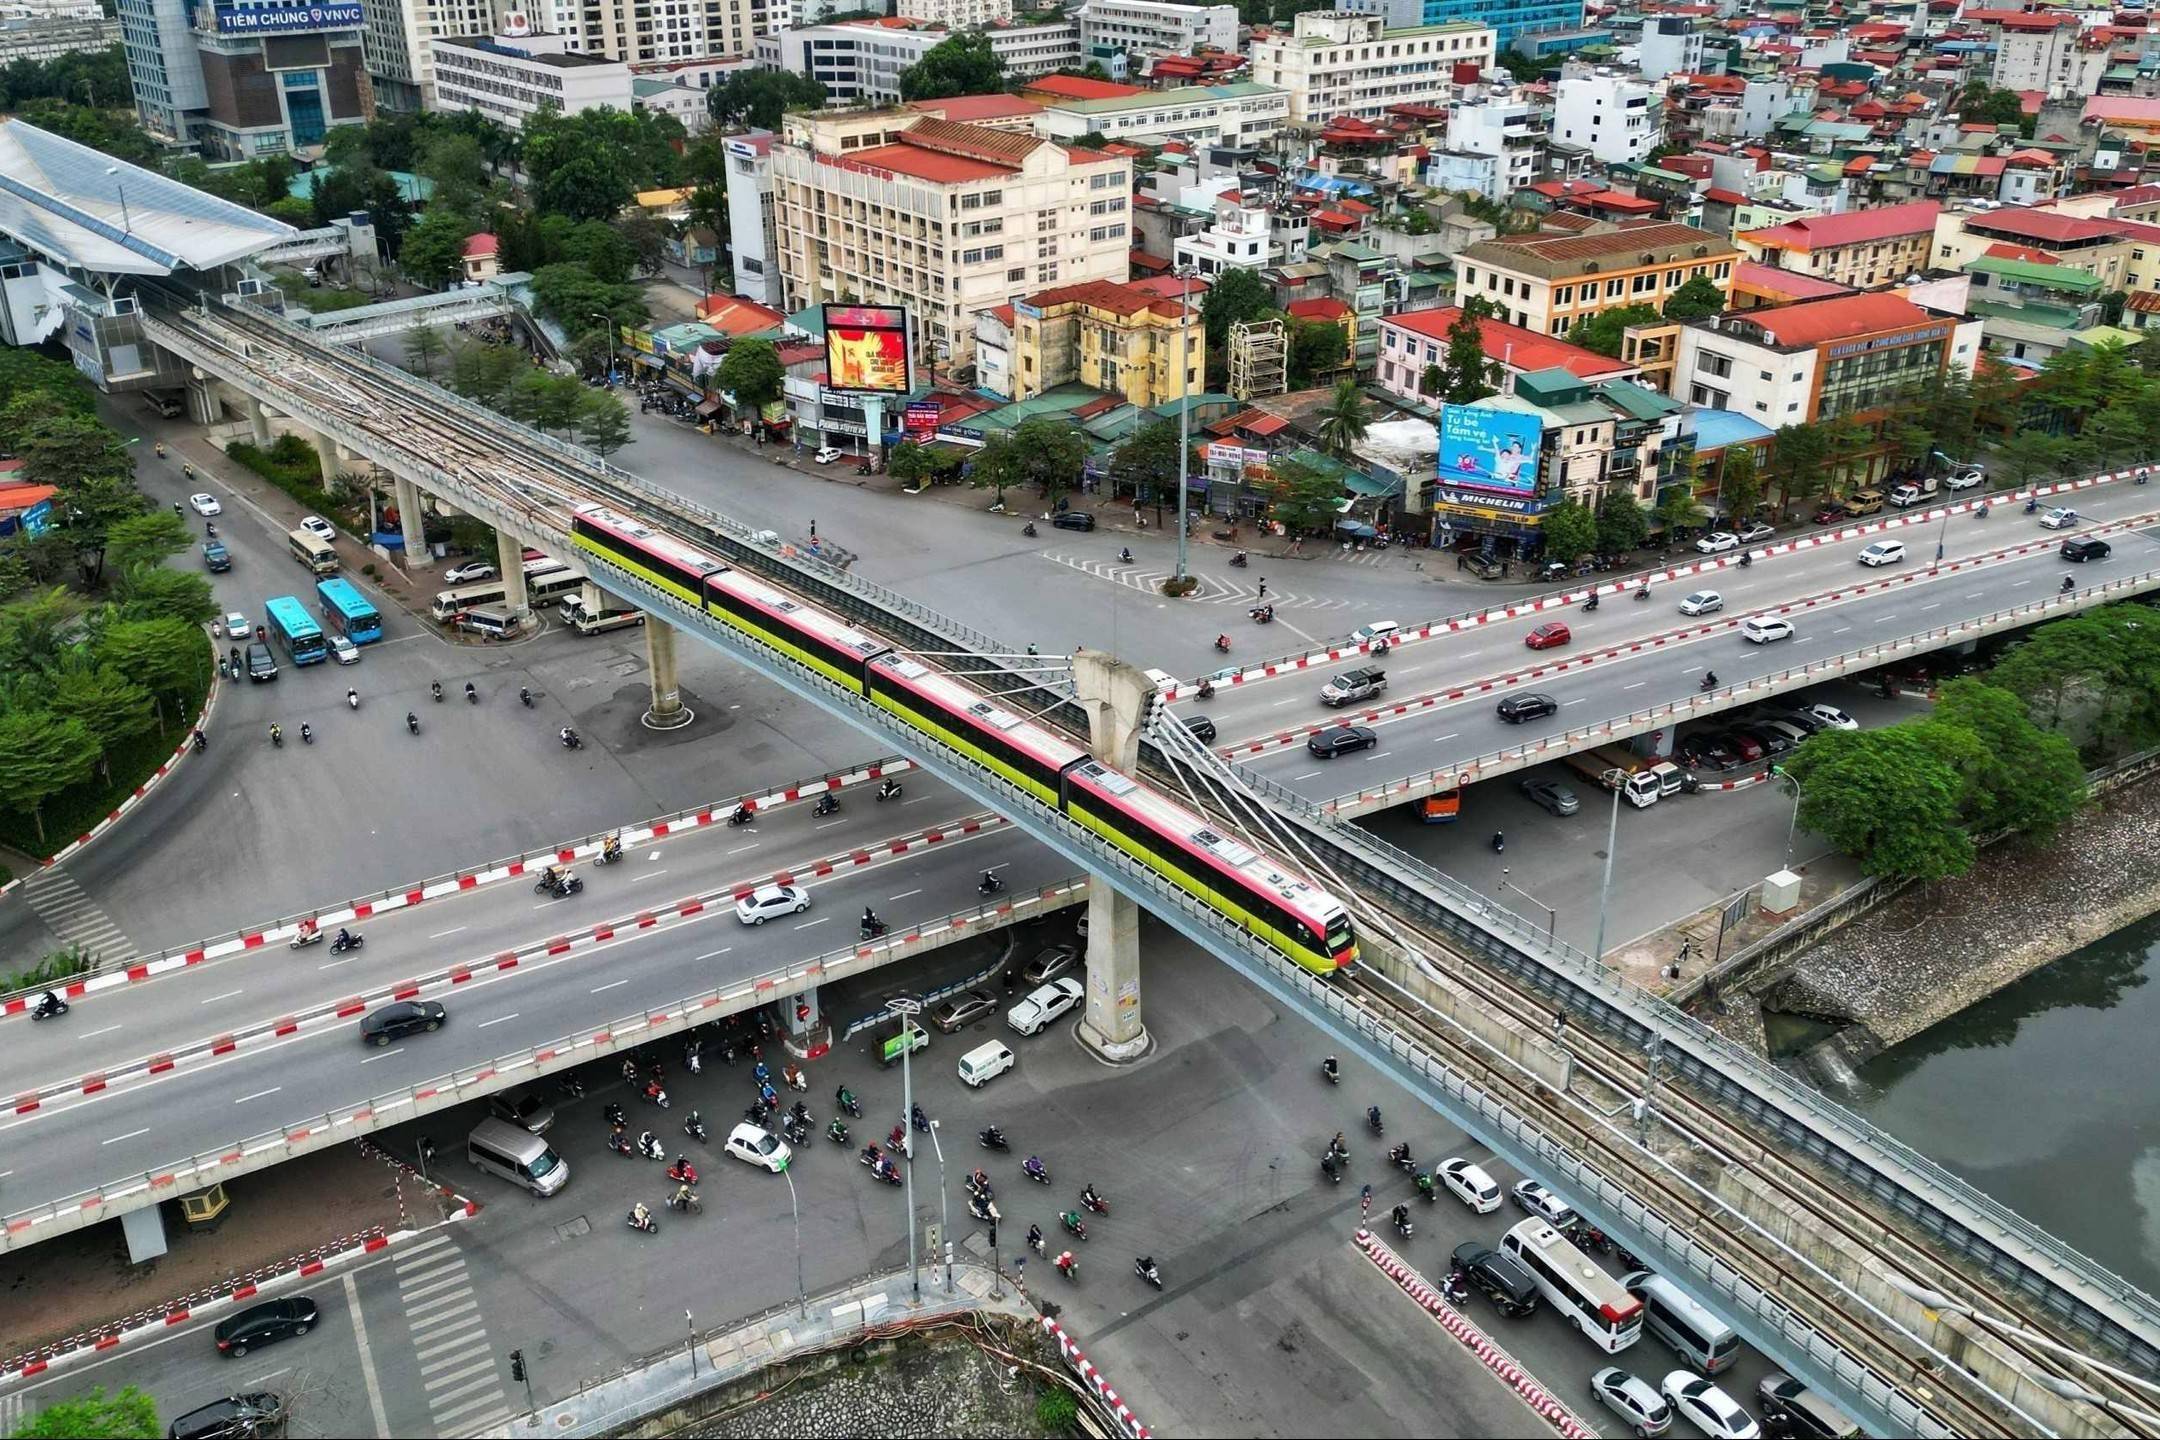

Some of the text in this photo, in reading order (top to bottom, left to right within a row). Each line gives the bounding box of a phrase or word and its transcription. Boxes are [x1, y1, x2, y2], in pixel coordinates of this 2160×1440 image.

[223, 13, 257, 27] TIÊM
[323, 8, 360, 20] VNVC
[1461, 494, 1525, 509] MICHELIN
